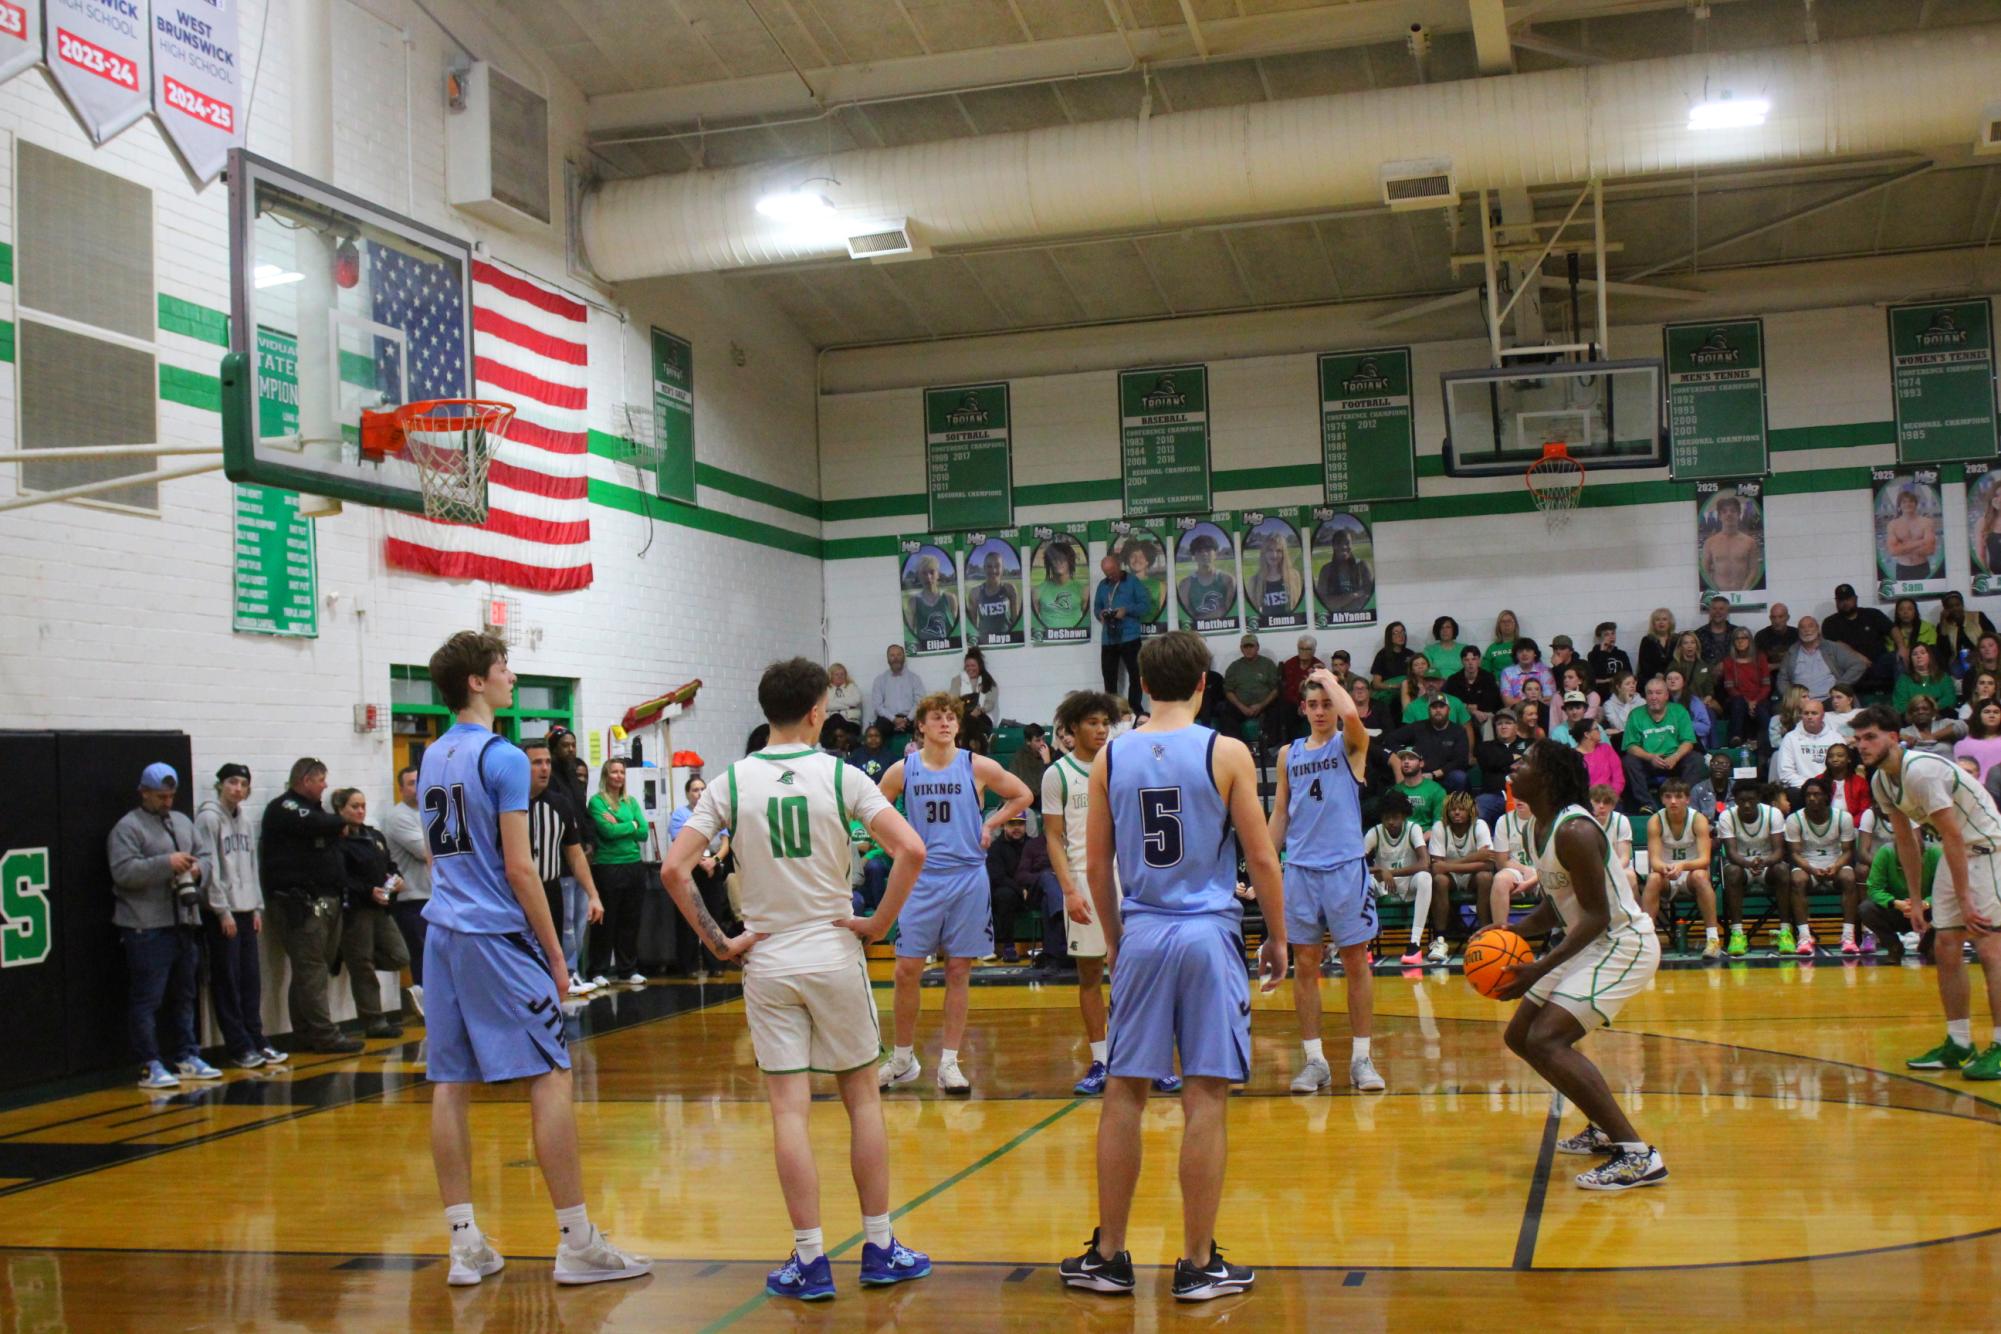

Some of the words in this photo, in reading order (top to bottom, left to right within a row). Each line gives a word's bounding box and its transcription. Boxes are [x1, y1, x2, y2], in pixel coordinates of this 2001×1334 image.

[176, 8, 212, 39] WEST
[157, 15, 234, 67] BRUNSWICK
[60, 34, 135, 85] 2023-24
[160, 38, 185, 62] HIGH
[188, 52, 233, 85] SCHOOL
[167, 81, 231, 126] 2024-25
[1915, 331, 1967, 345] TROJANS
[1690, 350, 1739, 363] TROJANS
[1897, 353, 1946, 365] WOMEN'S
[1949, 350, 1988, 361] TENNIS
[1680, 372, 1711, 382] MEN'S
[1714, 370, 1750, 380] TENNIS
[1342, 378, 1388, 392] TROJANS
[1141, 394, 1186, 409] TROJANS
[1342, 398, 1391, 409] FOOTBALL
[946, 411, 989, 425] TROJANS
[1141, 414, 1188, 424] BASEBALL
[1358, 419, 1377, 429] 2012
[946, 431, 990, 441] SOFTBALL
[1872, 470, 1895, 481] 2025
[1696, 482, 1719, 492] 2025
[1144, 518, 1165, 527] 2025
[1067, 524, 1087, 534] 2025
[934, 535, 953, 545] 2025
[1902, 582, 1924, 593] Sam
[1730, 592, 1742, 604] Ty
[978, 602, 1010, 617] WEST
[1268, 616, 1295, 626] Emma
[1332, 612, 1372, 623] AhYanna
[1197, 619, 1235, 630] Matthew
[988, 633, 1011, 645] Maya
[1048, 629, 1088, 640] DeShawn
[926, 639, 950, 650] Elijah
[1292, 757, 1339, 777] VIKINGS
[913, 783, 962, 796] VIKINGS
[1309, 778, 1323, 802] 4
[926, 801, 951, 823] 30
[424, 783, 475, 858] 21
[766, 795, 812, 858] 10
[1138, 786, 1184, 869] 5
[1672, 848, 1687, 860] 15
